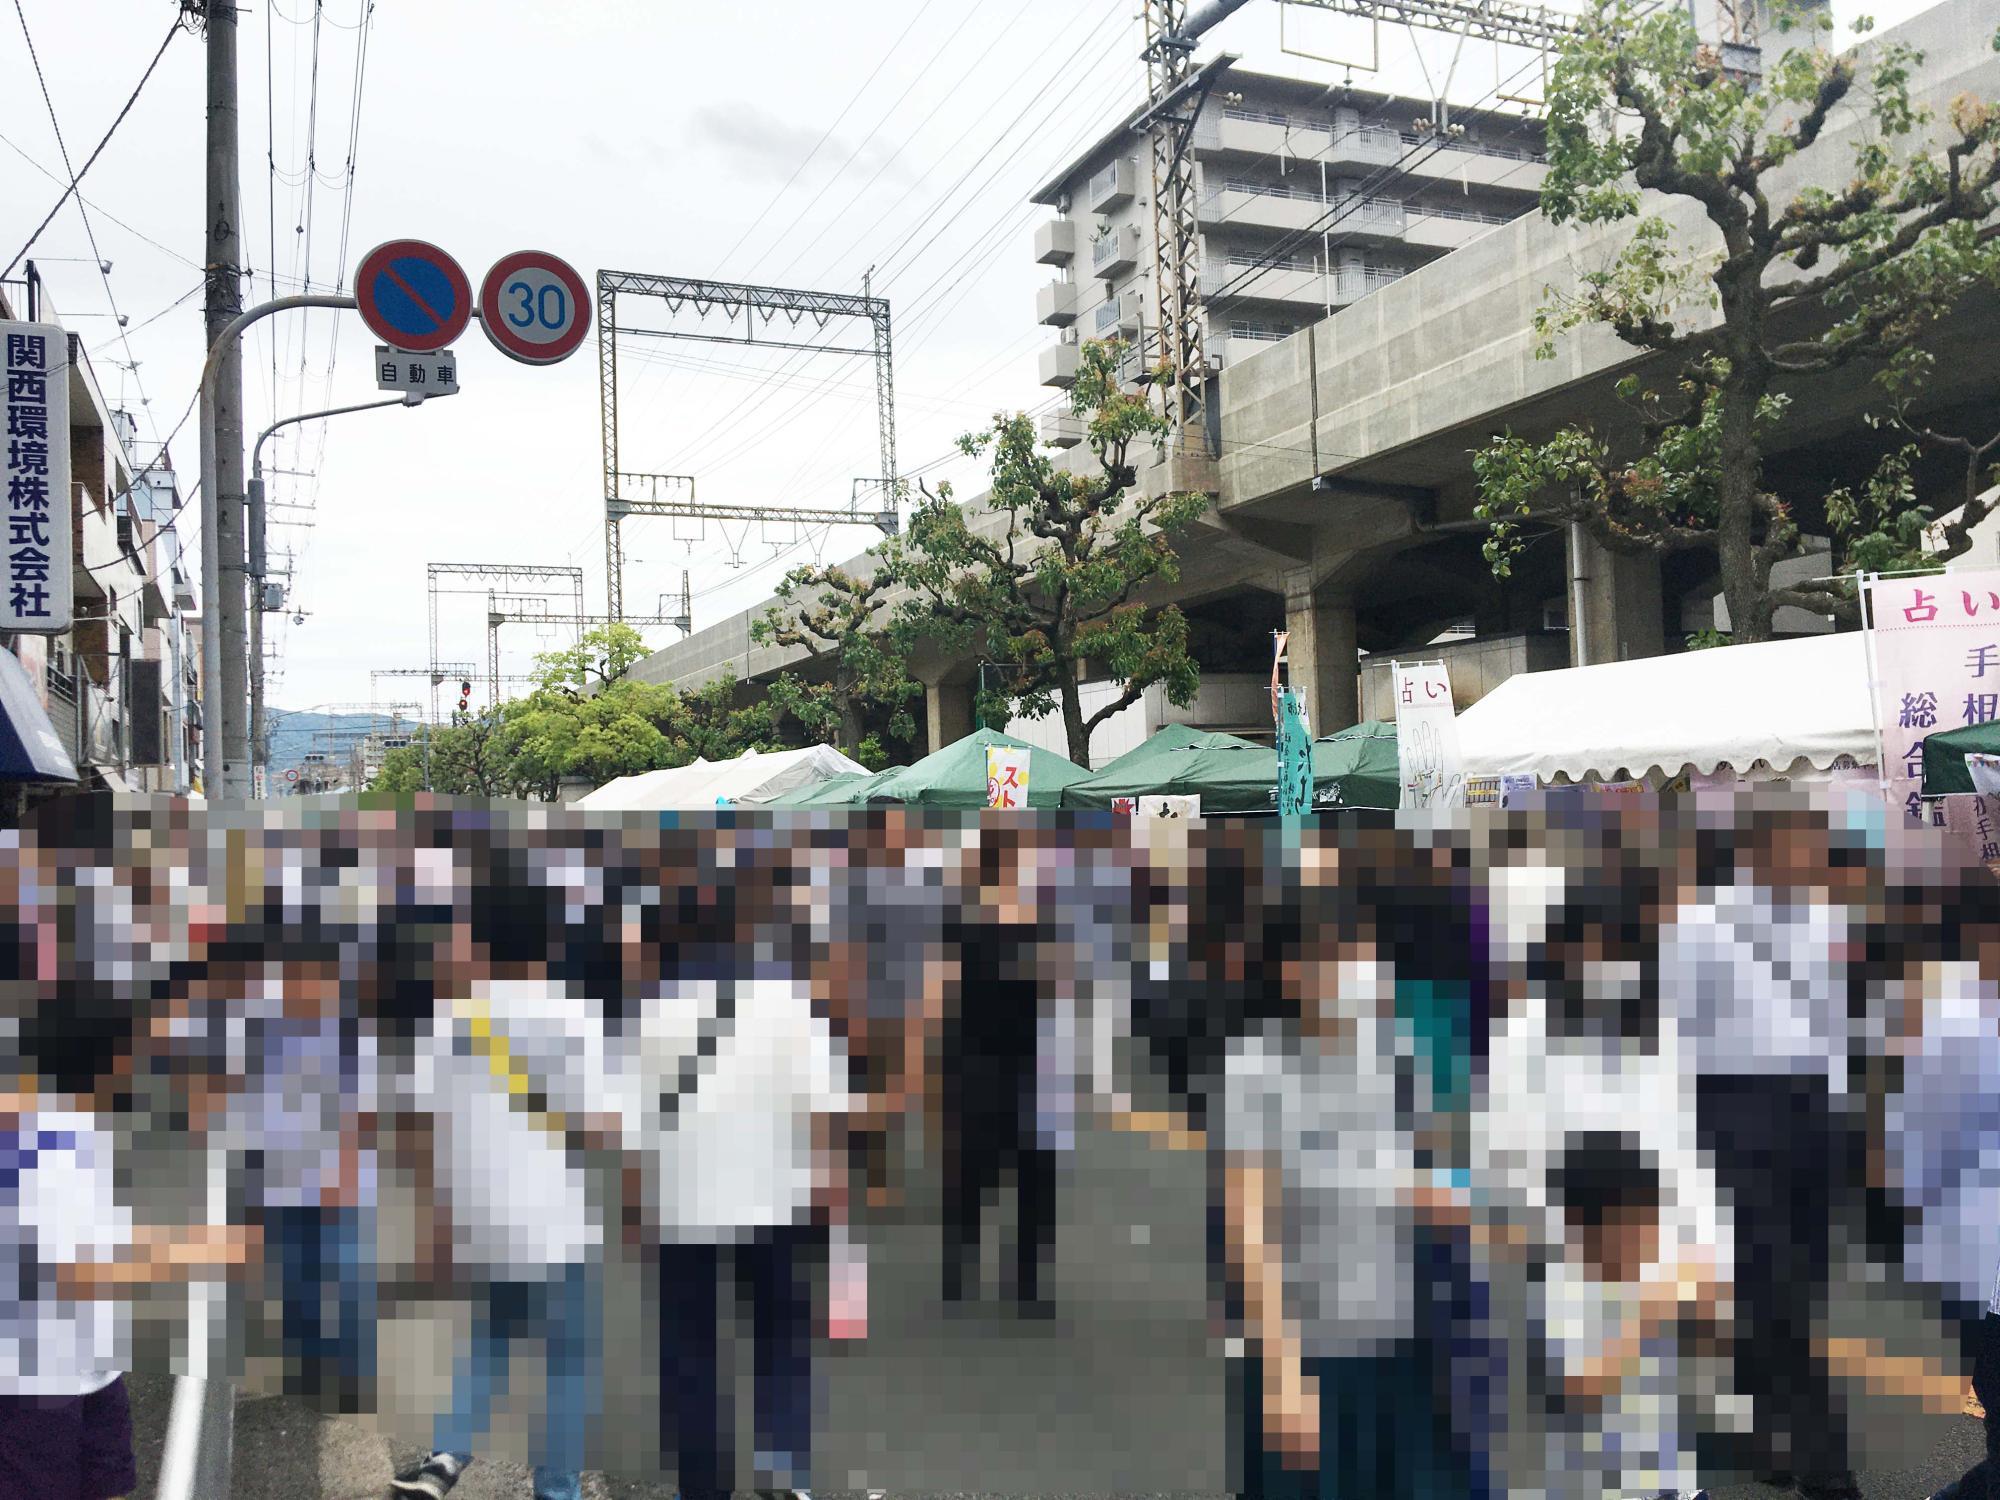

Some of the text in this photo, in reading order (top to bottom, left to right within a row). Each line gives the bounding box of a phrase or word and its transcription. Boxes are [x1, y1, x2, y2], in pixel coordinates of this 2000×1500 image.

[508, 281, 565, 330] 30
[381, 361, 454, 385] 自動車
[7, 333, 51, 618] 関西環境株式会社
[1902, 588, 2000, 623] 占い
[1402, 676, 1448, 704] 占い
